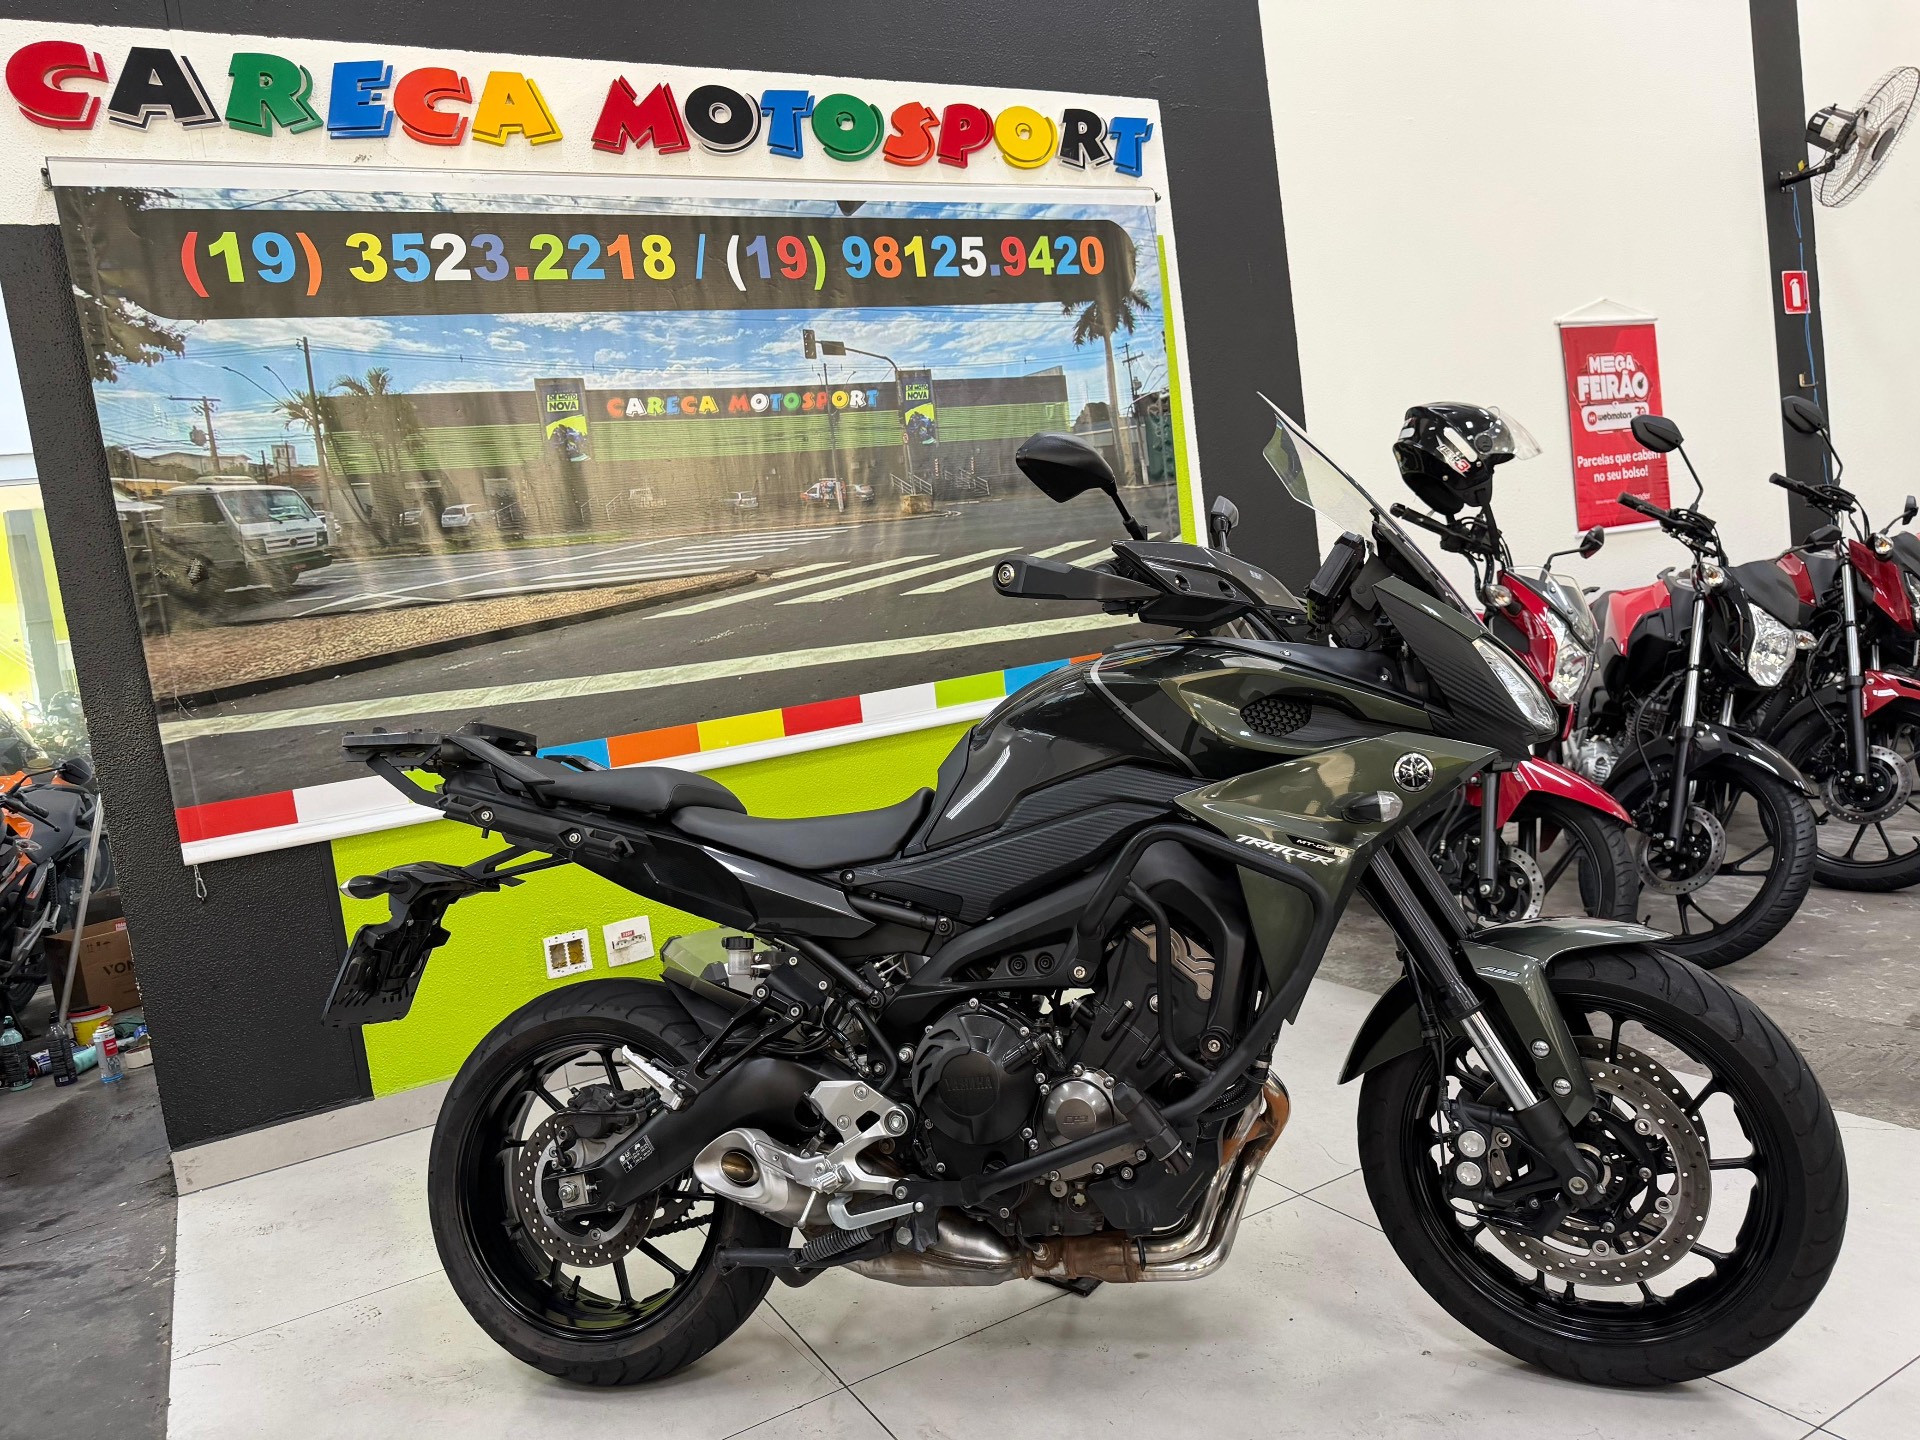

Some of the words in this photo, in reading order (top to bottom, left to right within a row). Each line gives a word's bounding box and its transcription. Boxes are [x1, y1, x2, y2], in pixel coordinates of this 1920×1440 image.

[5, 40, 563, 147] CARECA
[592, 75, 1153, 177] MOTOSPORT
[181, 231, 322, 297] (19)
[346, 232, 675, 283] 3523.2218
[695, 233, 706, 279] /
[727, 235, 826, 291] (19)
[842, 235, 1105, 278] 98125.9420
[1588, 355, 1636, 374] MEGA
[1577, 369, 1649, 402] FEIRÃO
[606, 395, 720, 418] CARECA
[728, 388, 879, 414] MOTOSPORT
[907, 391, 928, 400] NOVA
[549, 401, 577, 411] NOVA
[1598, 411, 1632, 421] webmotors
[1577, 453, 1615, 468] Parcelas
[1615, 452, 1631, 466] que
[1593, 472, 1605, 483] no
[1606, 469, 1621, 481] seu
[1622, 464, 1649, 479] bolso!
[1236, 834, 1335, 866] TRACER
